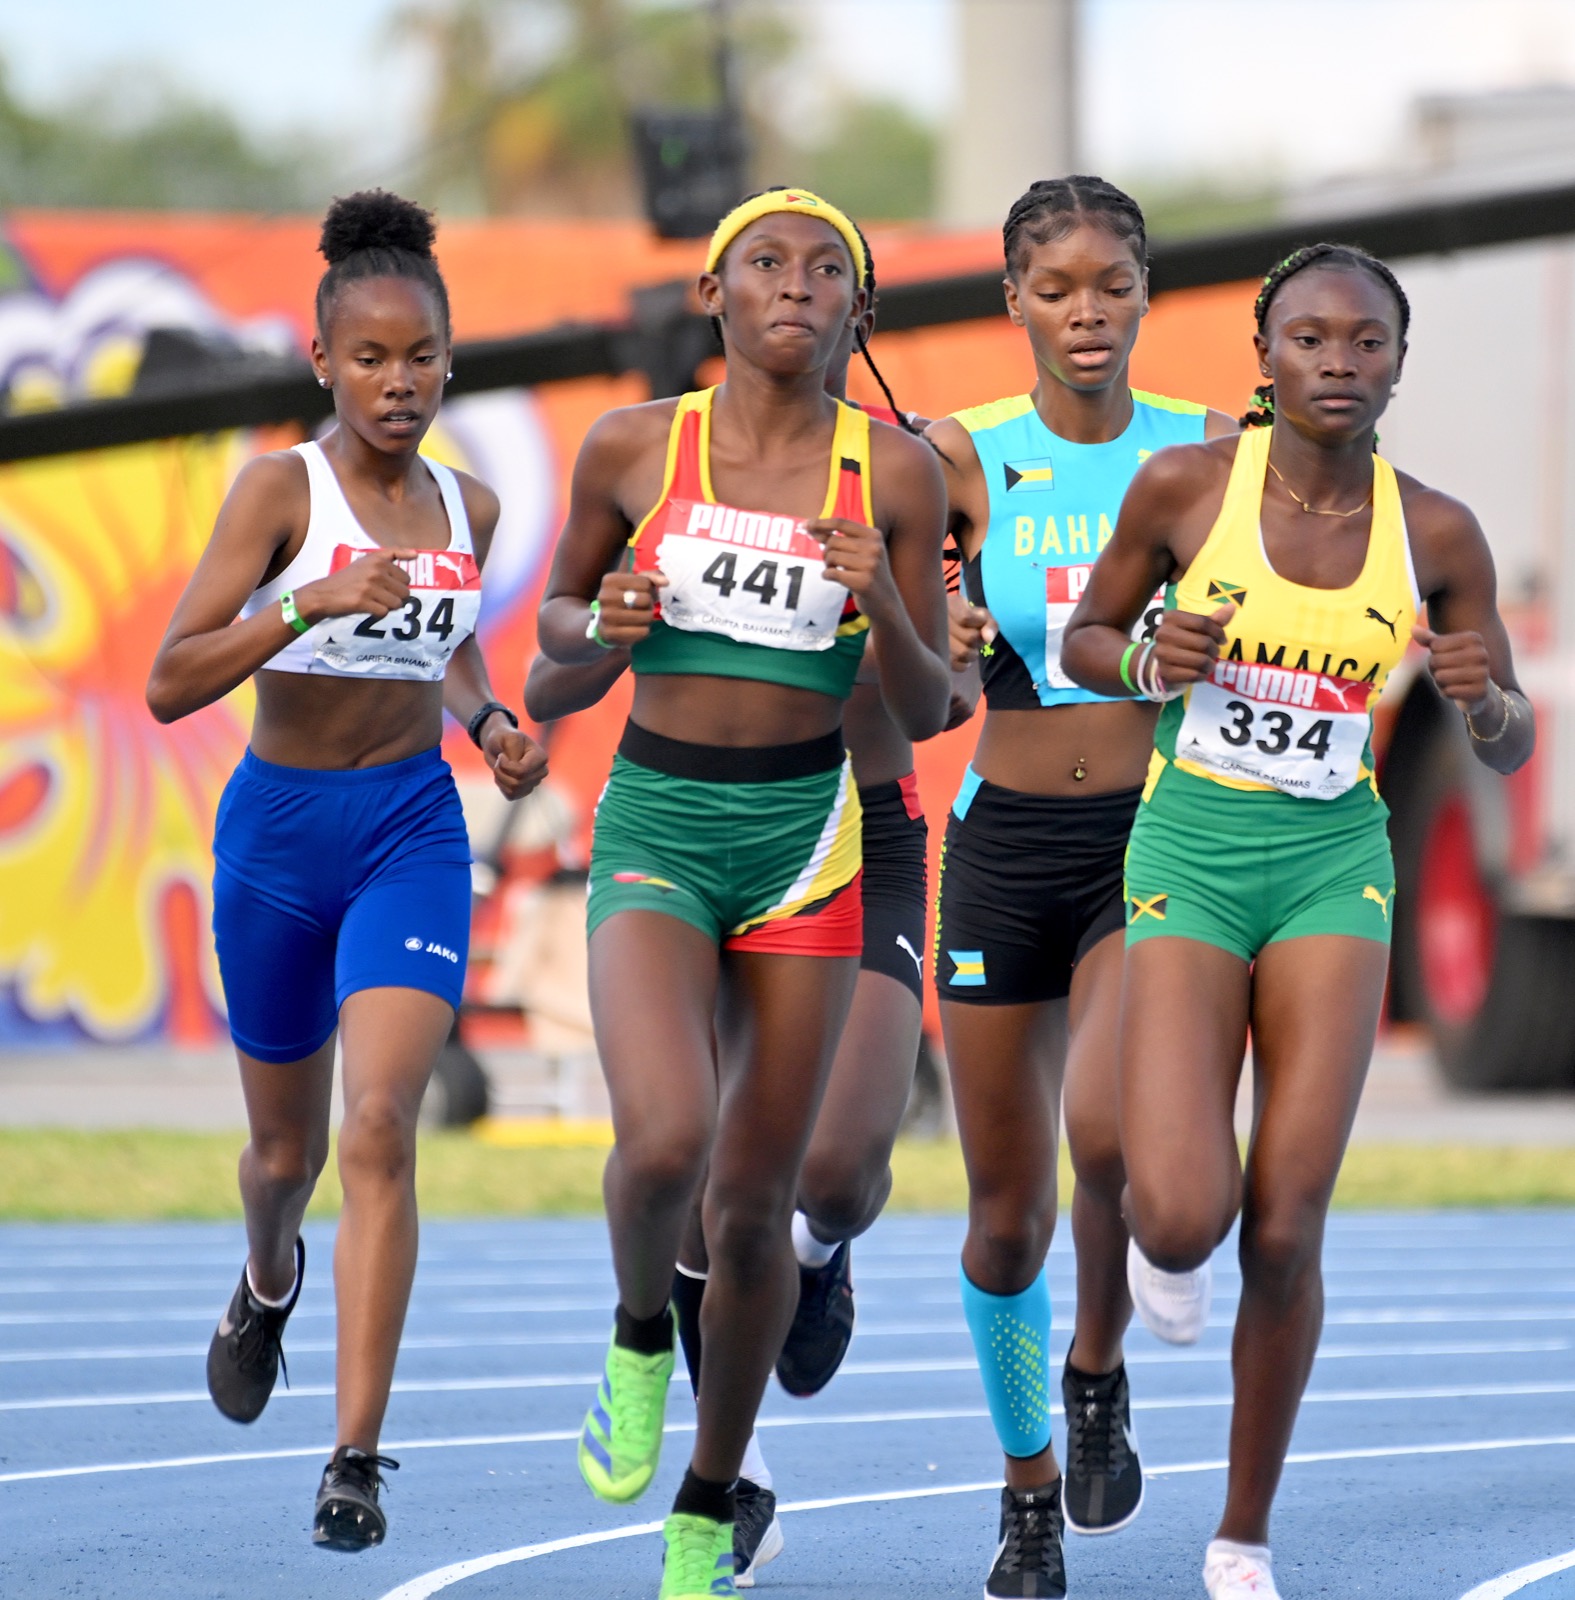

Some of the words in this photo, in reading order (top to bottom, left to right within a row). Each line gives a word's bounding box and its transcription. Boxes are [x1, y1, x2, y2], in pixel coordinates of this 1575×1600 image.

[686, 504, 795, 552] PUMA
[1014, 513, 1115, 556] BAHA
[702, 552, 805, 610] 441
[353, 596, 455, 642] 234
[1213, 660, 1318, 708] PUMA
[1227, 638, 1380, 683] AMAICA
[1220, 701, 1334, 761] 334
[425, 942, 459, 964] JAKO
